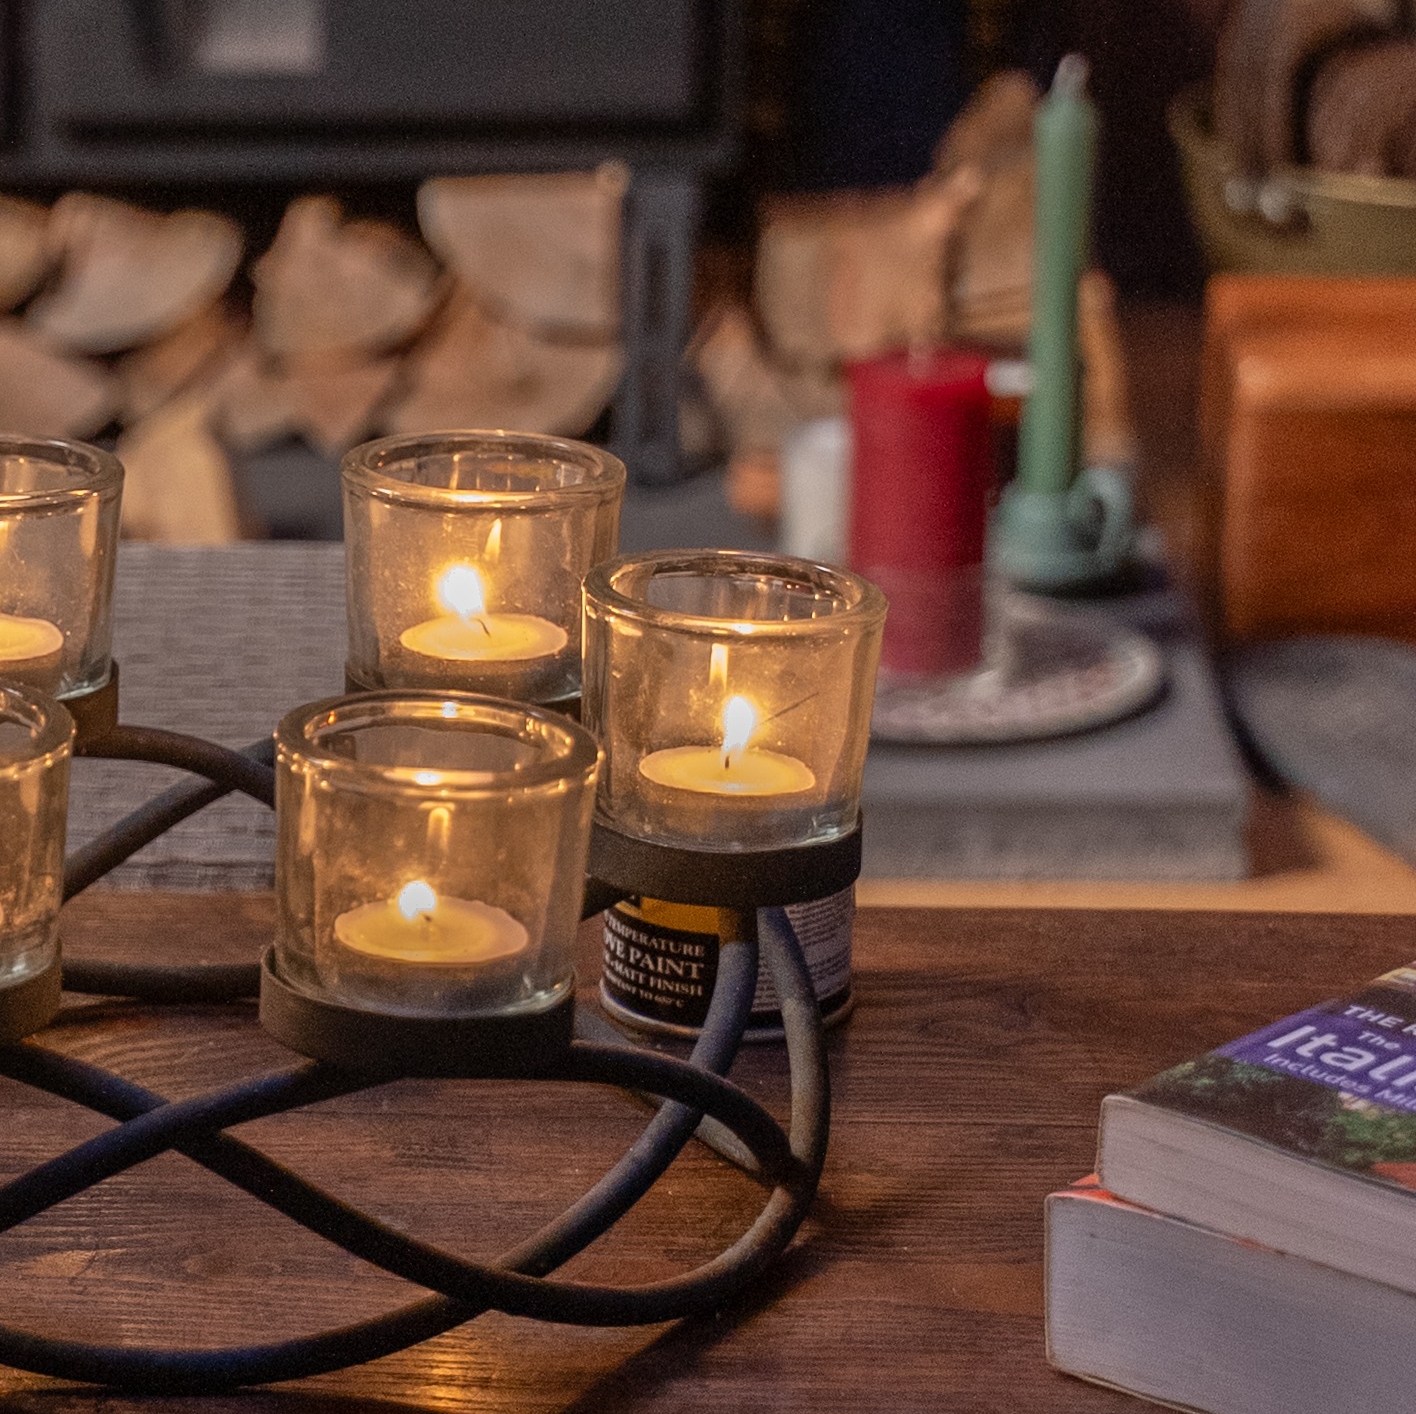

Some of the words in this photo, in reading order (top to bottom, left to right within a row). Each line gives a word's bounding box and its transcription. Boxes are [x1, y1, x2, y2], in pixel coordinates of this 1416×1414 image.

[629, 947, 704, 979] PAINT
[650, 976, 703, 997] FINISH
[1344, 1005, 1404, 1028] THE
[1357, 1030, 1401, 1051] The
[1263, 1053, 1372, 1094] Includes
